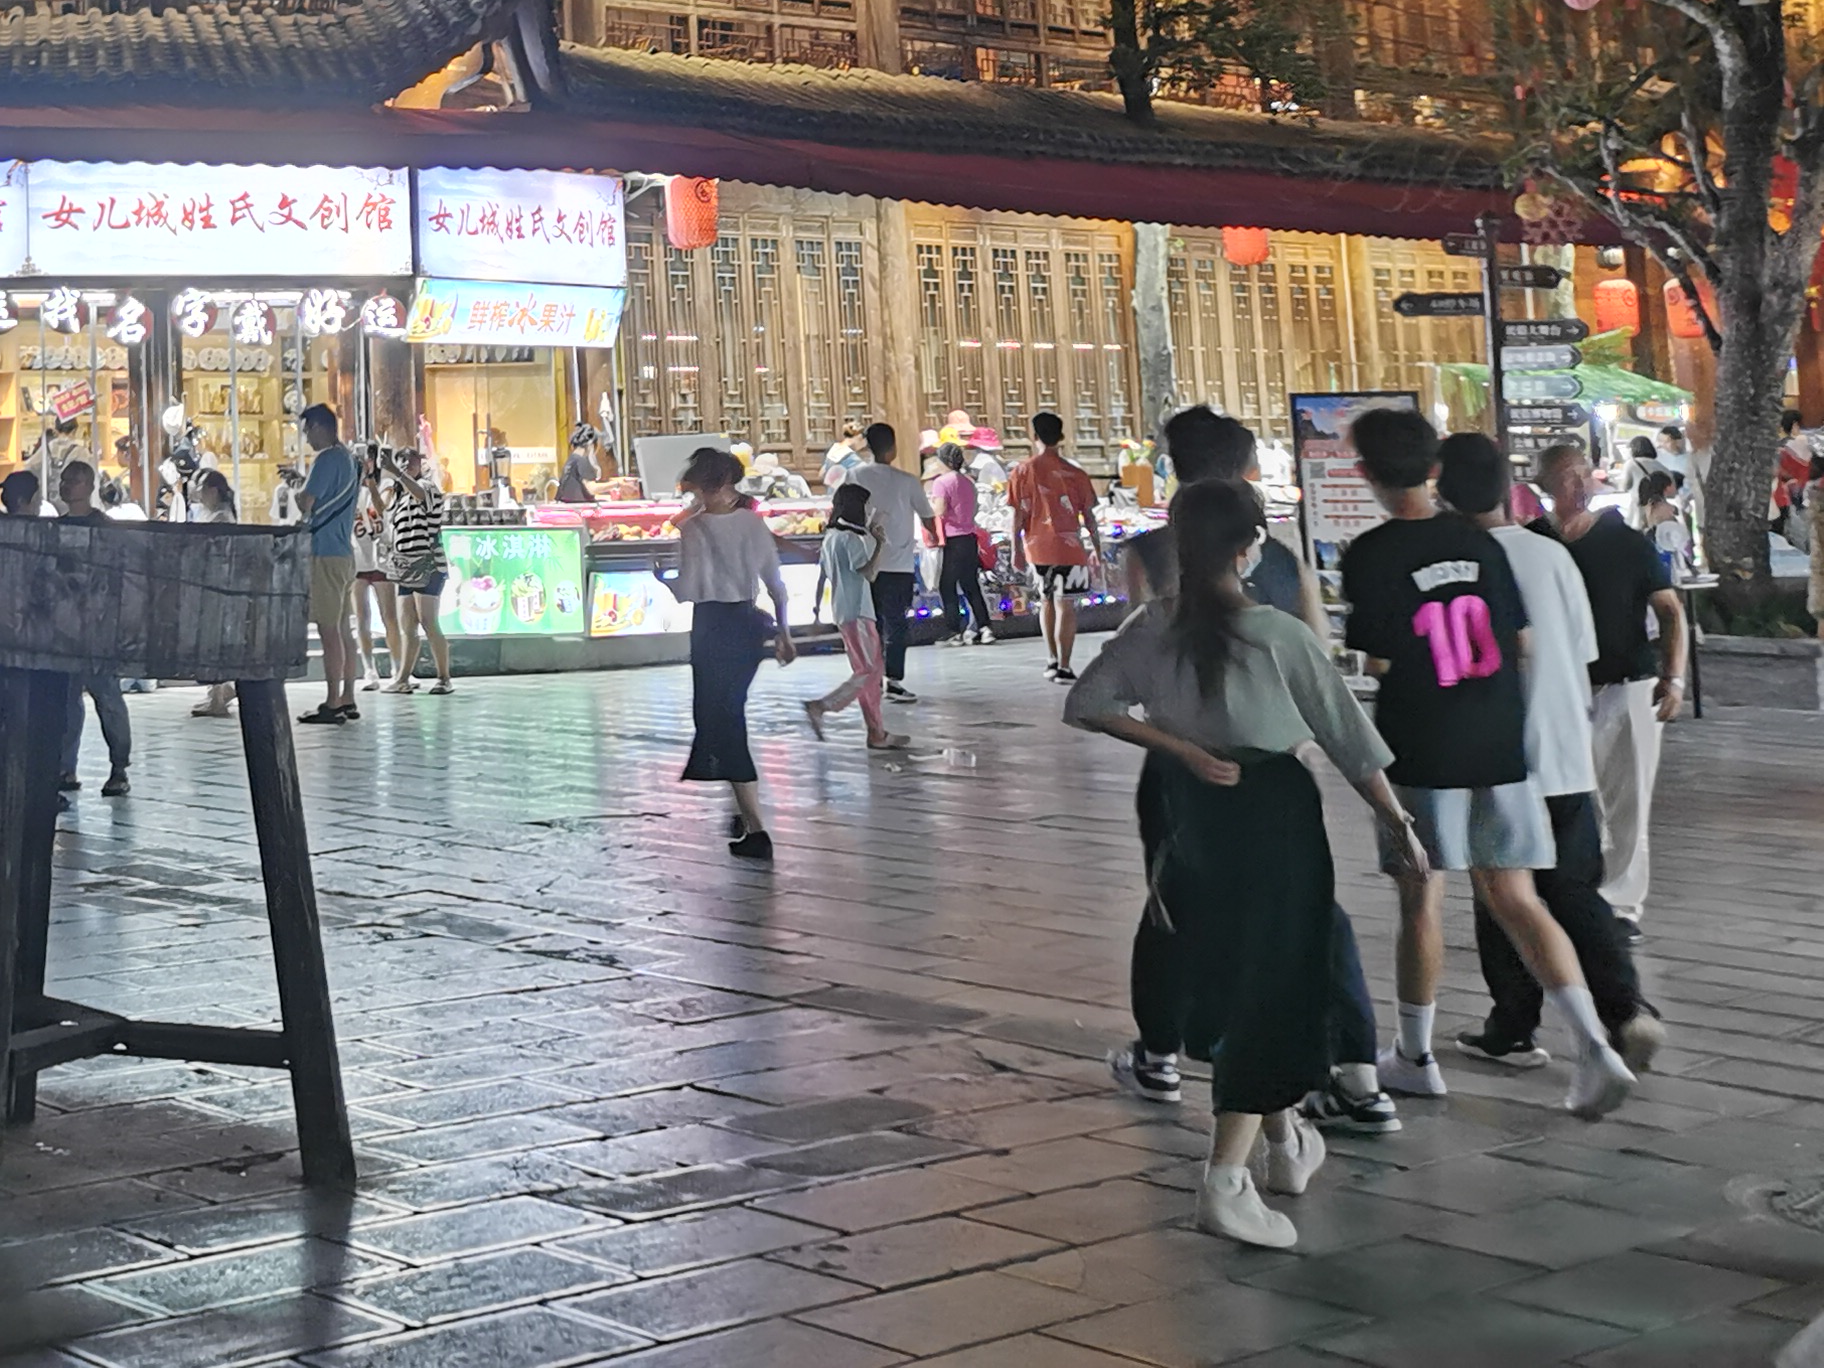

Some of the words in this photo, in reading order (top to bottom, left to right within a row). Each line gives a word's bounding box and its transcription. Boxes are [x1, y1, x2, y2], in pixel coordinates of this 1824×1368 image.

[41, 191, 397, 236] 女儿城姓氏文创馆
[428, 198, 617, 248] 女儿城姓氏文创馆
[467, 293, 576, 334] 鲜榨冰果汁
[475, 534, 552, 560] 冰淇淋
